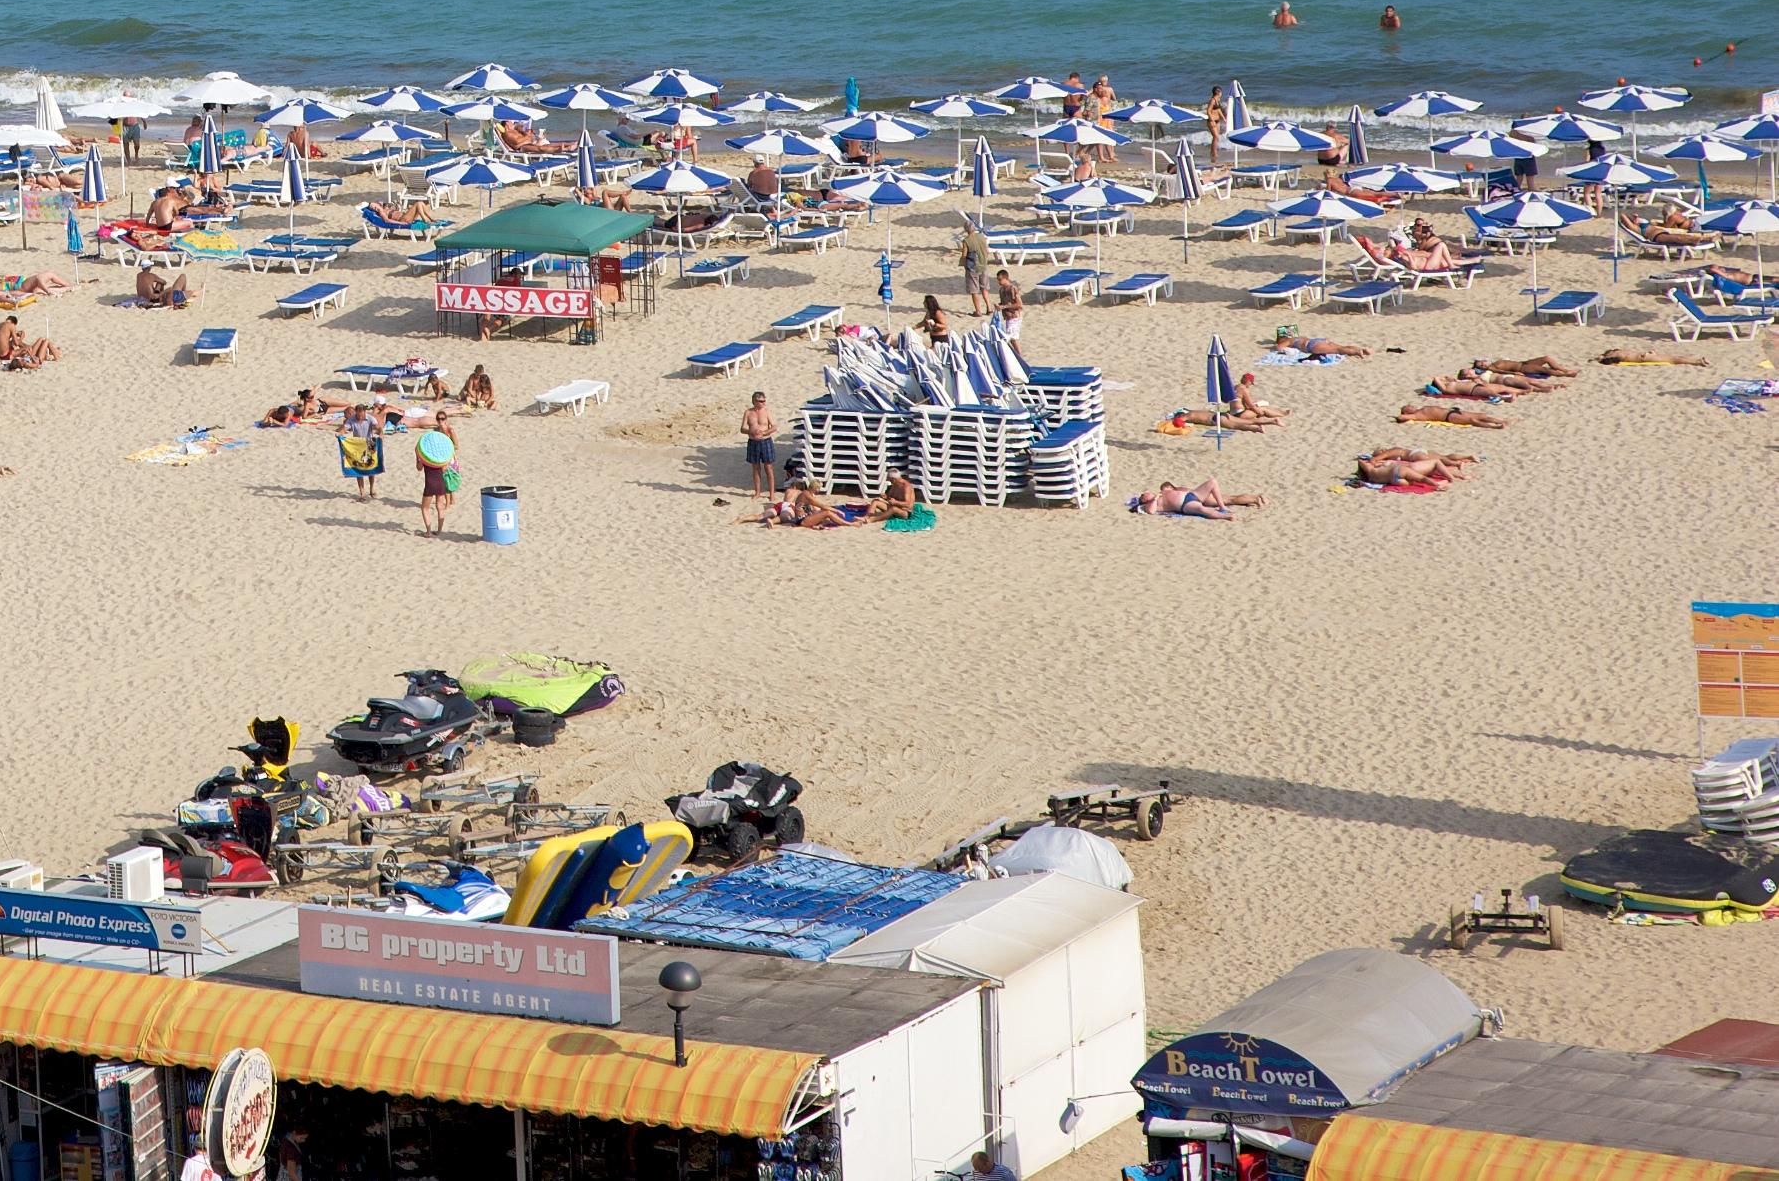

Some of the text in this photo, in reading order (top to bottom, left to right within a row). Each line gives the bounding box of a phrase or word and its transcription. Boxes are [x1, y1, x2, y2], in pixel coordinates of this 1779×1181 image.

[440, 286, 588, 315] MASSAGE
[10, 905, 54, 924] Digital
[56, 910, 96, 927] Photo
[99, 915, 151, 934] Express
[150, 912, 197, 923] FOTO VICTORIA
[320, 922, 587, 977] BG property Ltd
[359, 977, 552, 1012] REAL ESTATE AGENT
[1165, 1050, 1316, 1088] BeachTowel
